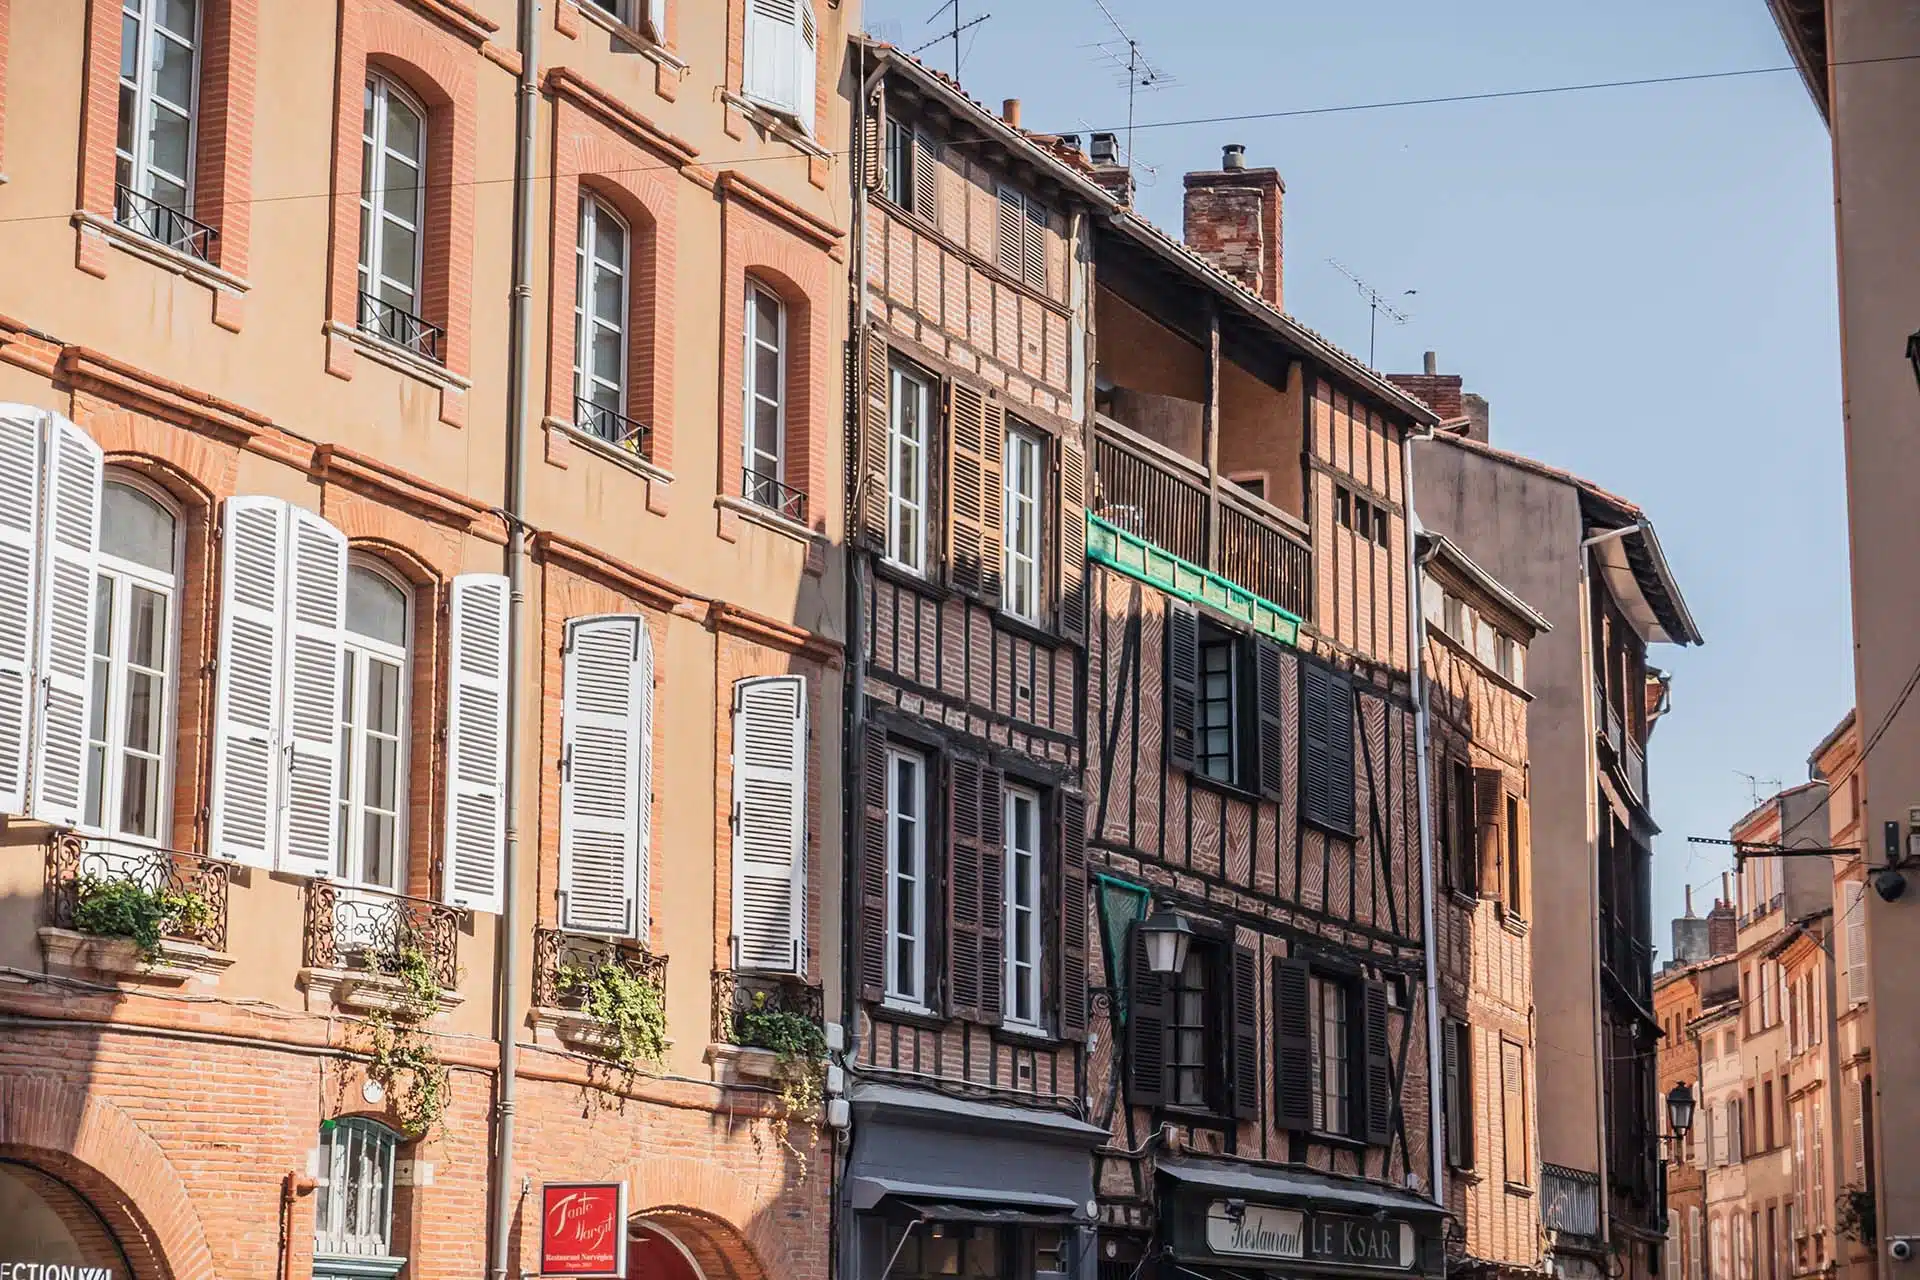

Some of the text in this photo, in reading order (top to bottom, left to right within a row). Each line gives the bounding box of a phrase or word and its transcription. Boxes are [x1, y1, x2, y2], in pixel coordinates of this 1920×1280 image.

[548, 1191, 602, 1237] Tante
[1231, 1215, 1393, 1260] Restaurant LE KSAR
